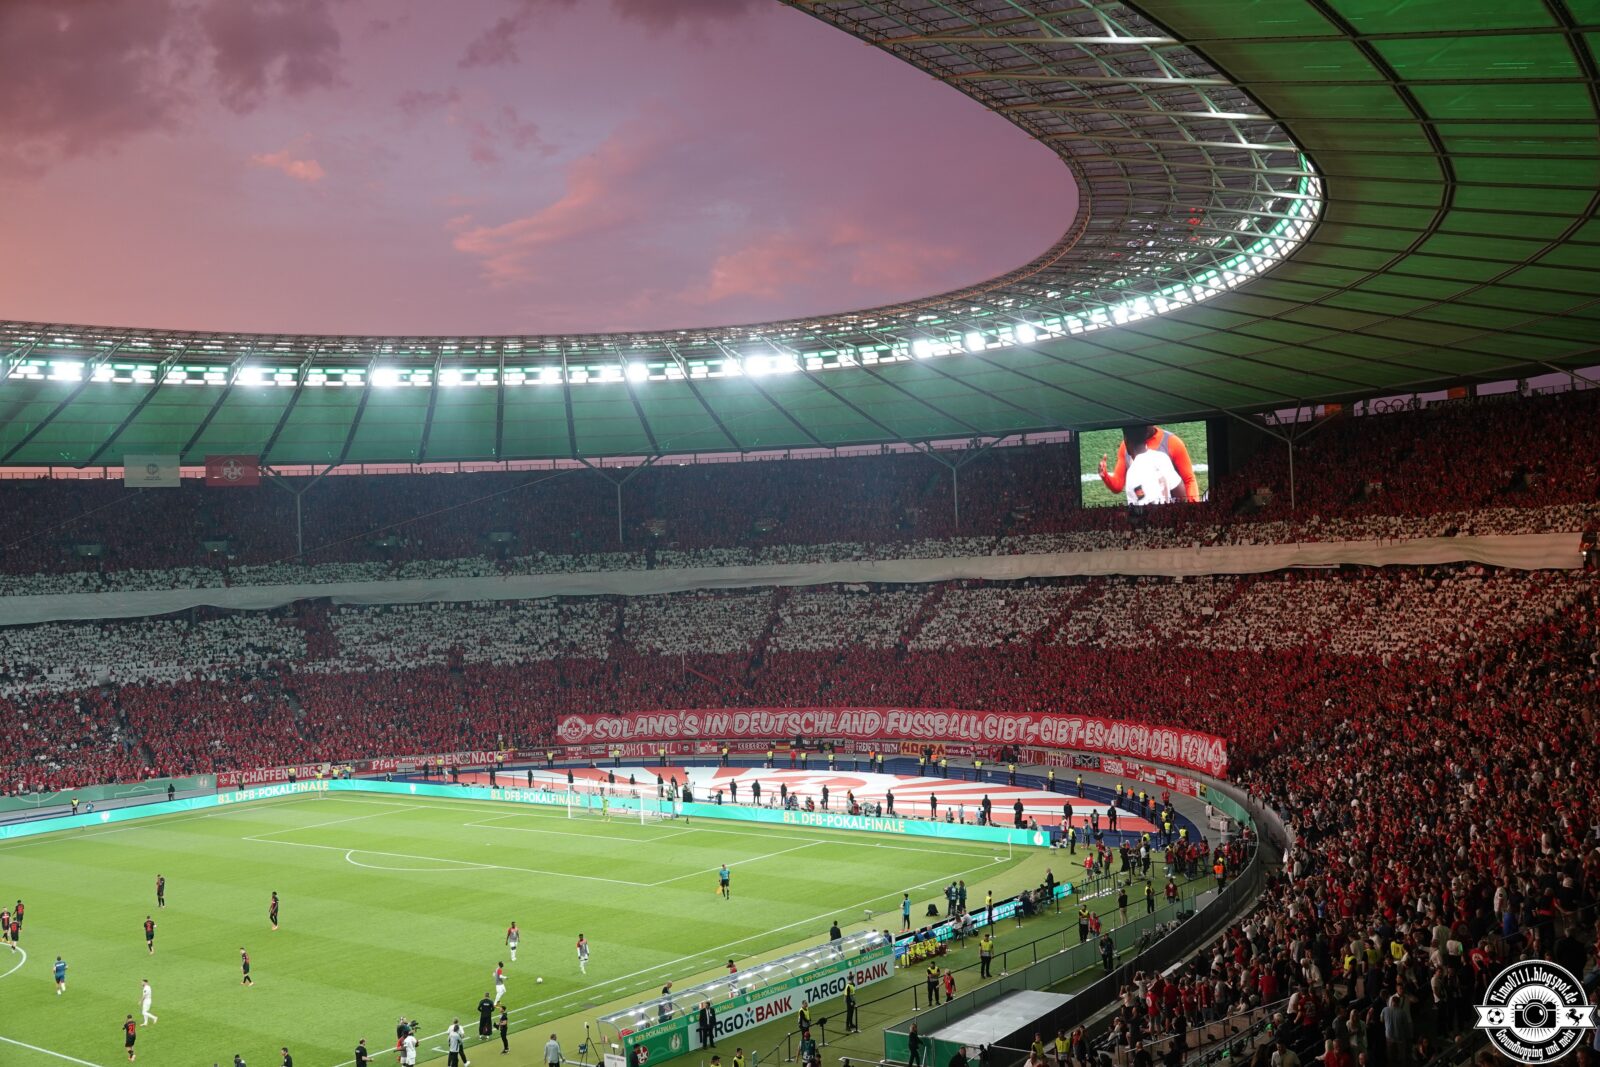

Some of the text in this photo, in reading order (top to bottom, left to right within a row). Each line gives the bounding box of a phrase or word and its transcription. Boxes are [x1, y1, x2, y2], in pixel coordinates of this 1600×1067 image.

[594, 711, 700, 739] SOLANG'S
[703, 714, 731, 736] IN
[733, 711, 881, 737] DEUTSCHLAND
[886, 710, 980, 740] FUSSBALL
[1040, 716, 1083, 746] GIBT
[1084, 720, 1107, 749] ES
[1106, 722, 1149, 756] AUCH
[1151, 729, 1178, 761] DEN
[229, 766, 316, 785] ASCHAFFENURG
[235, 781, 329, 801] DFB-POKALFINALE
[504, 791, 581, 805] DFB-POKALFINALE
[783, 811, 906, 833] 81. DFB-POKALFINALE
[696, 1014, 743, 1043] TRGO
